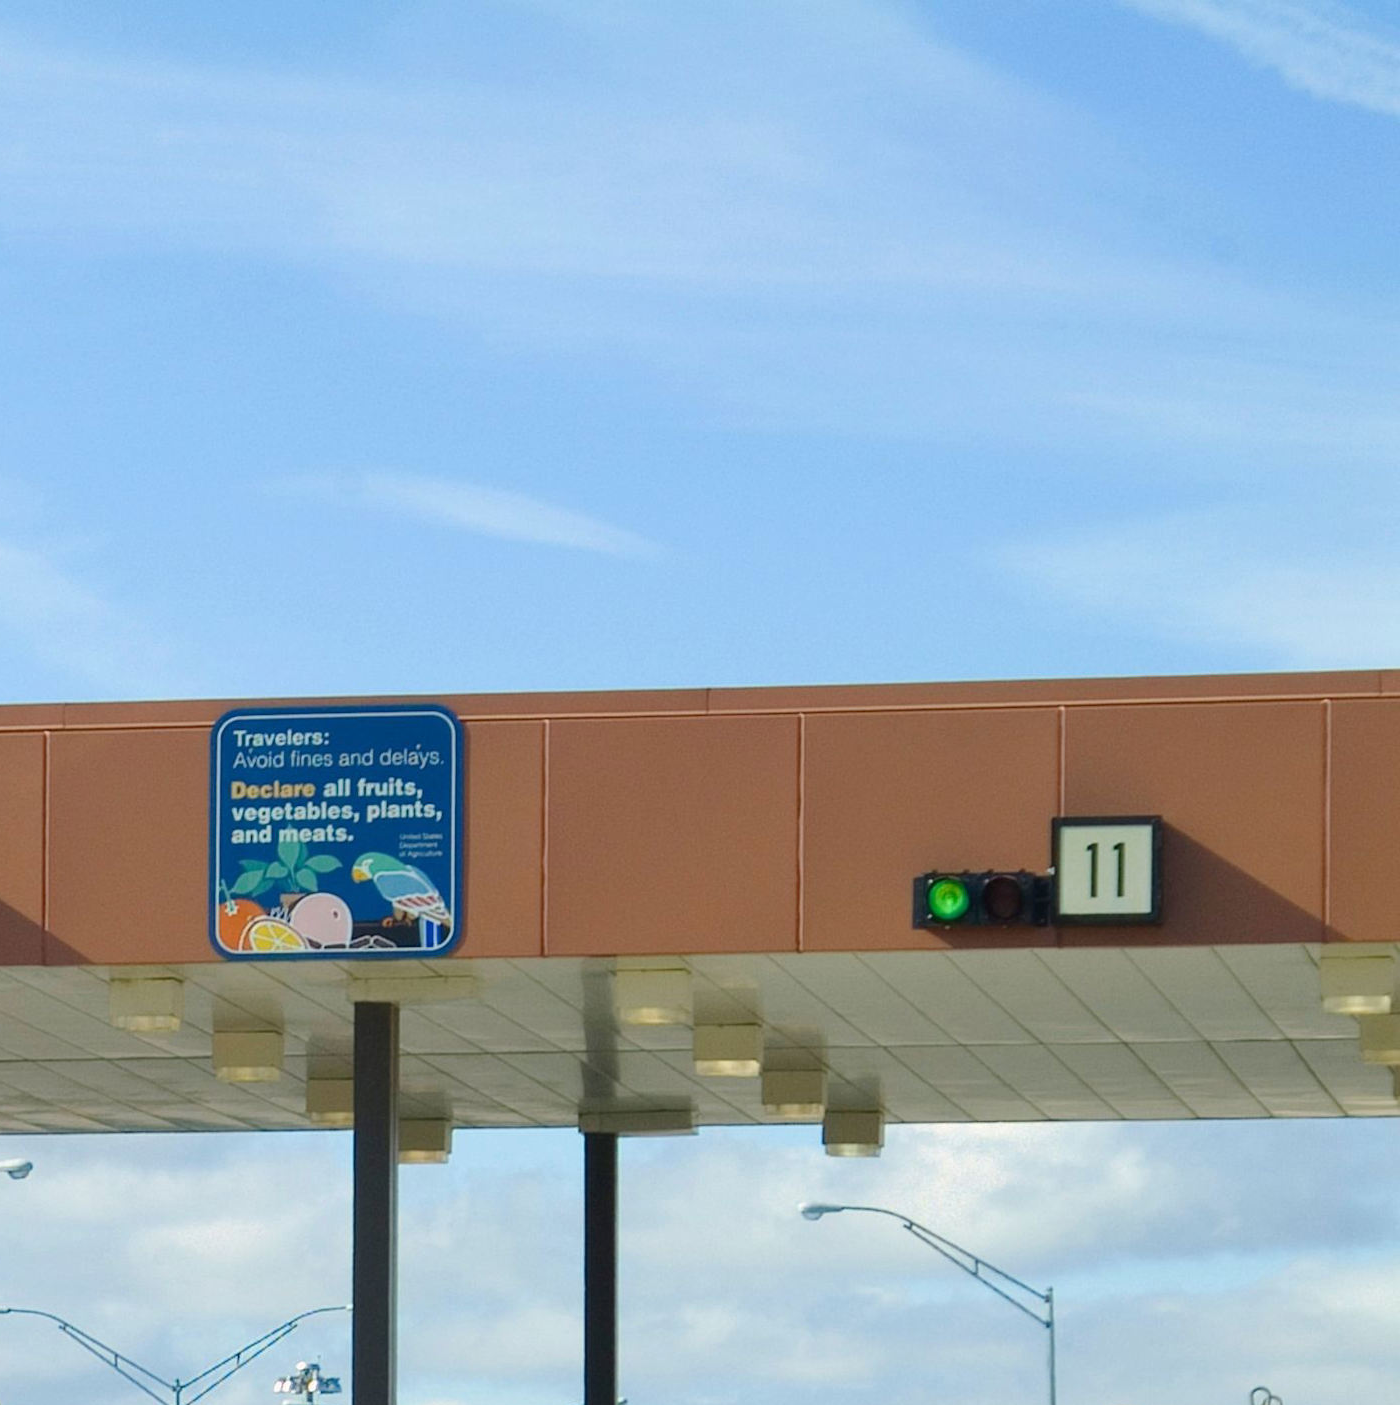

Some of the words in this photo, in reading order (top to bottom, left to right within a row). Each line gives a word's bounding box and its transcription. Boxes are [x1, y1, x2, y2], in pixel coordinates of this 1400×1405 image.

[233, 730, 330, 747] Travelers:
[233, 751, 284, 769] Avoid
[291, 750, 333, 767] fines
[339, 749, 373, 766] and
[380, 748, 444, 769] delays.
[230, 780, 316, 799] Declare
[323, 779, 350, 797] all
[357, 777, 423, 799] fruits,
[231, 801, 360, 824] vegetables,
[366, 800, 443, 823] plants,
[231, 825, 272, 844] and
[278, 825, 354, 843] meats.
[1085, 842, 1125, 897] 11
